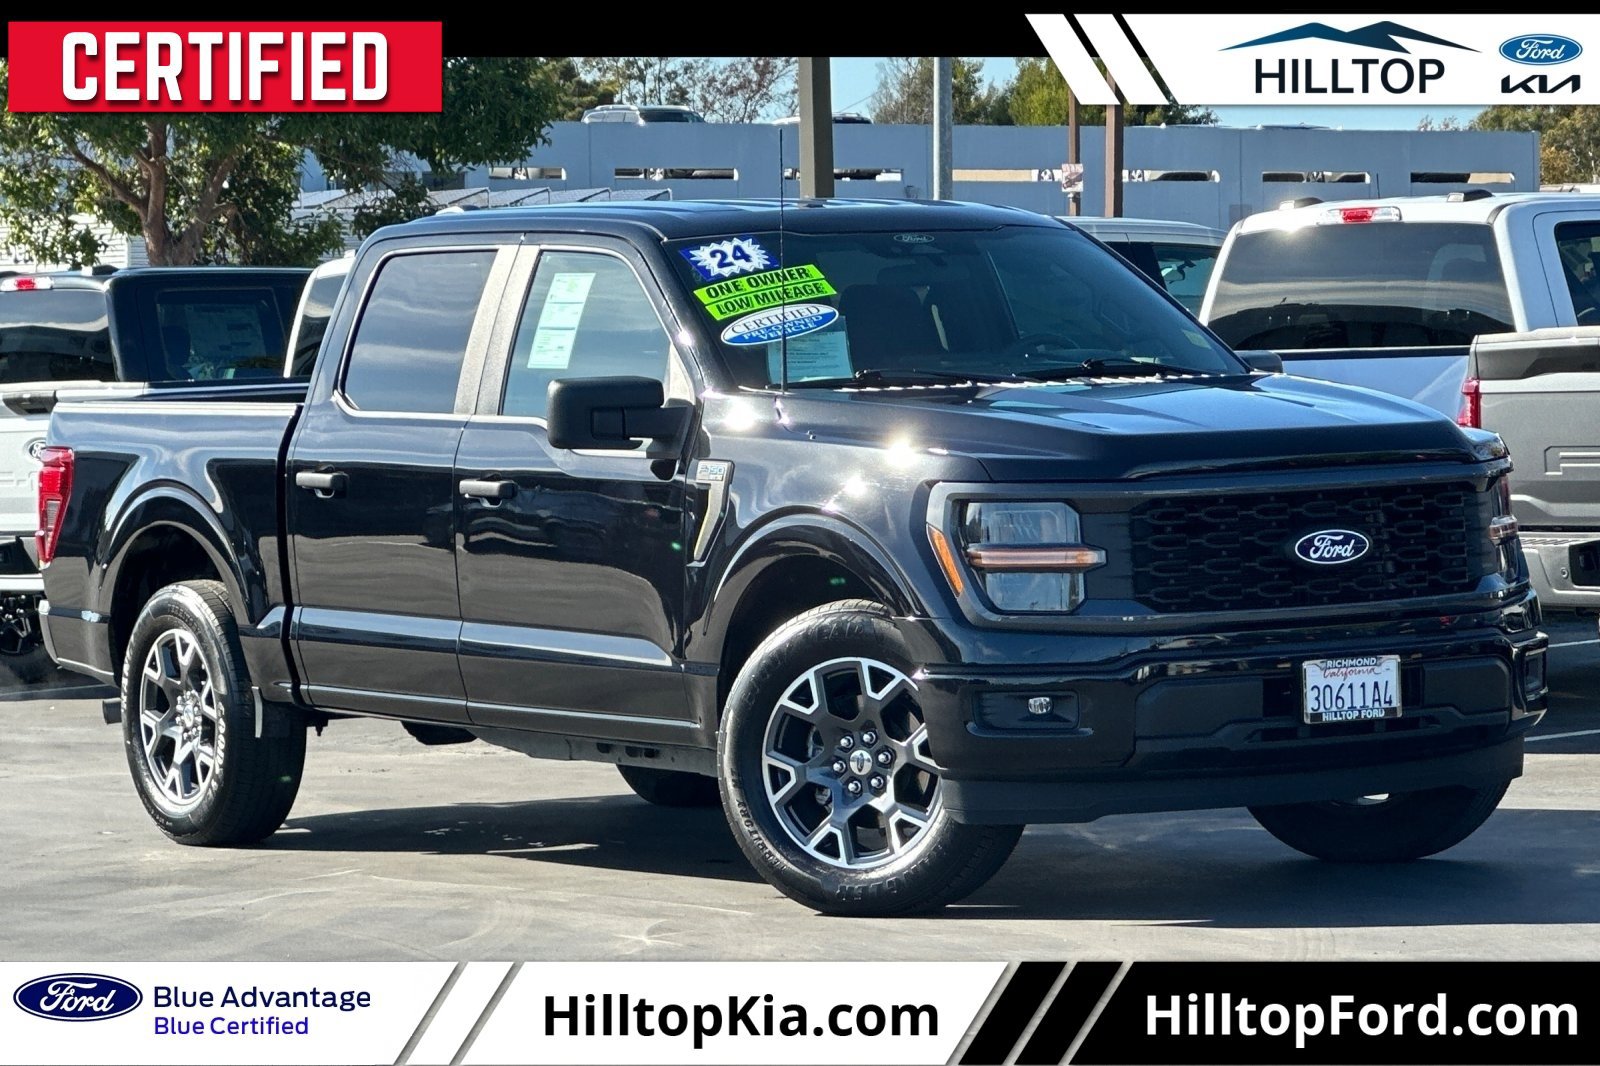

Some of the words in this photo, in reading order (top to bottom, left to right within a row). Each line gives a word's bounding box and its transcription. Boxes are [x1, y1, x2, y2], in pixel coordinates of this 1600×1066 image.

[709, 245, 752, 269] 24
[705, 281, 744, 299] ONE
[747, 267, 810, 289] OWNER
[715, 297, 752, 316] LOW
[755, 282, 824, 306] MILEAGE
[731, 305, 821, 334] CERTIFIED
[742, 315, 823, 340] PRE-OWNED
[1310, 534, 1355, 559] Ford
[1323, 667, 1381, 681] California
[1326, 657, 1377, 669] RICHMOND
[1310, 680, 1393, 712] 30611A4
[1322, 711, 1359, 722] HILLTOP
[1360, 709, 1385, 719] FORD
